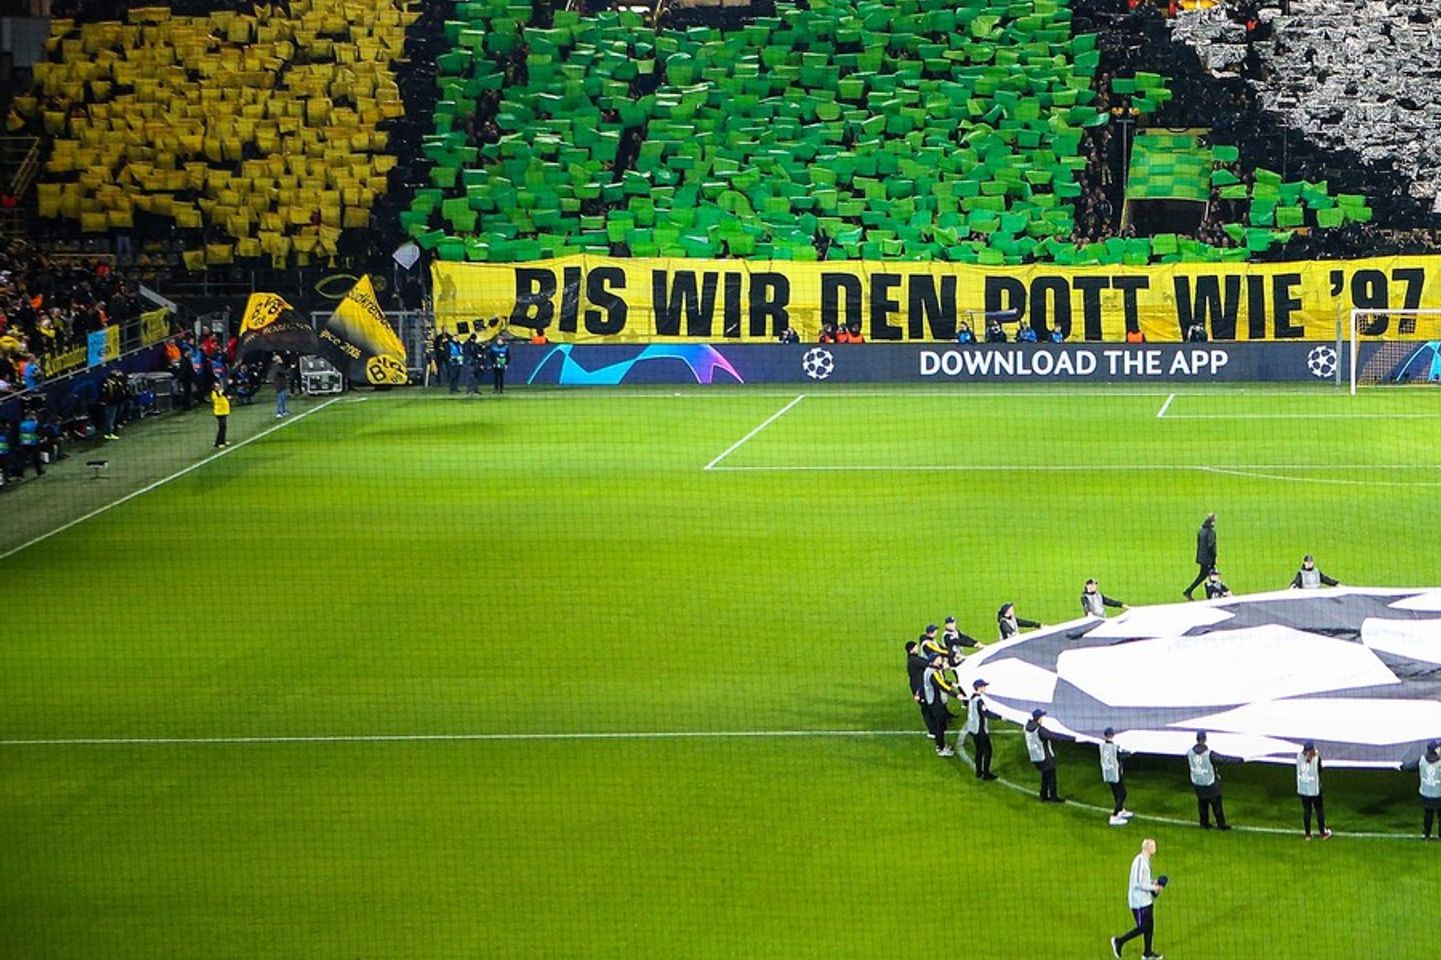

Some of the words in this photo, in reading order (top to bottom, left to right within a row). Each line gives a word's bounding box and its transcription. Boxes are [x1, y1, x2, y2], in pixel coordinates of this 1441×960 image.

[651, 269, 790, 338] WIR
[820, 272, 958, 340] DEN
[984, 274, 1149, 339] POTT
[1175, 273, 1305, 339] WIE
[919, 350, 1097, 375] DOWNLOAD
[1103, 351, 1162, 375] THE
[1169, 350, 1228, 375] APP
